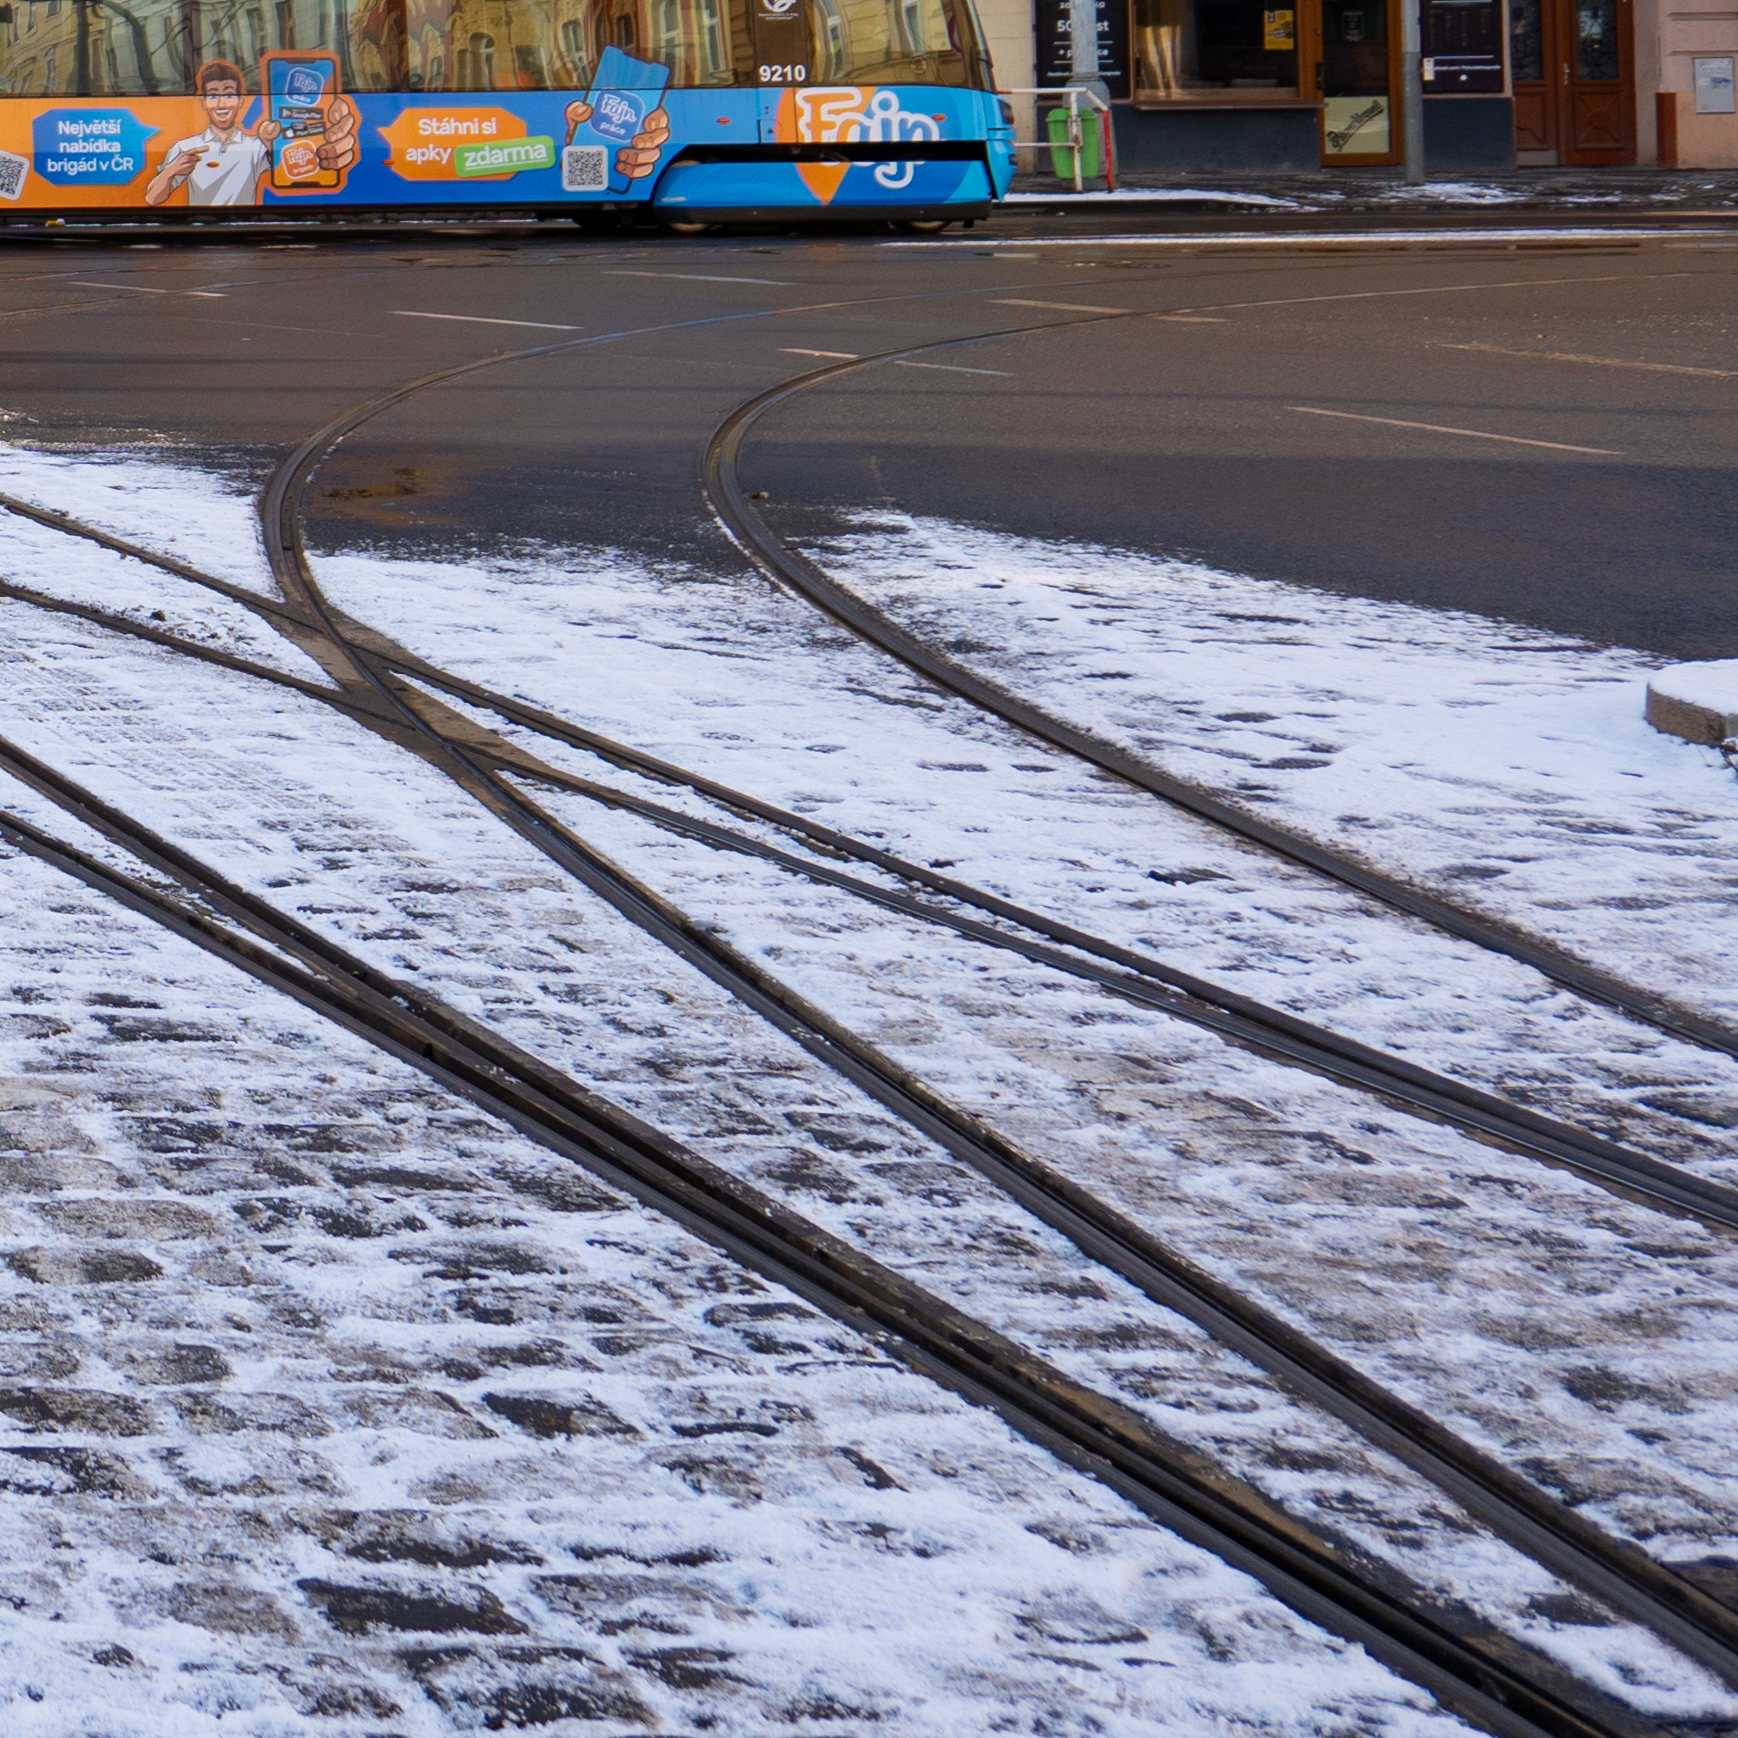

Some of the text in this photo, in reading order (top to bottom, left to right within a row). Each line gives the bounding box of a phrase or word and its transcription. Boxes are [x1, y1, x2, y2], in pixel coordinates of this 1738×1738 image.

[759, 64, 806, 82] 9210
[600, 94, 636, 123] Fajn
[58, 119, 122, 137] Největší
[418, 117, 497, 135] Stáhni si
[59, 138, 121, 153] nabídka
[406, 144, 547, 167] apky zdarma
[47, 154, 134, 176] brigád v ČR
